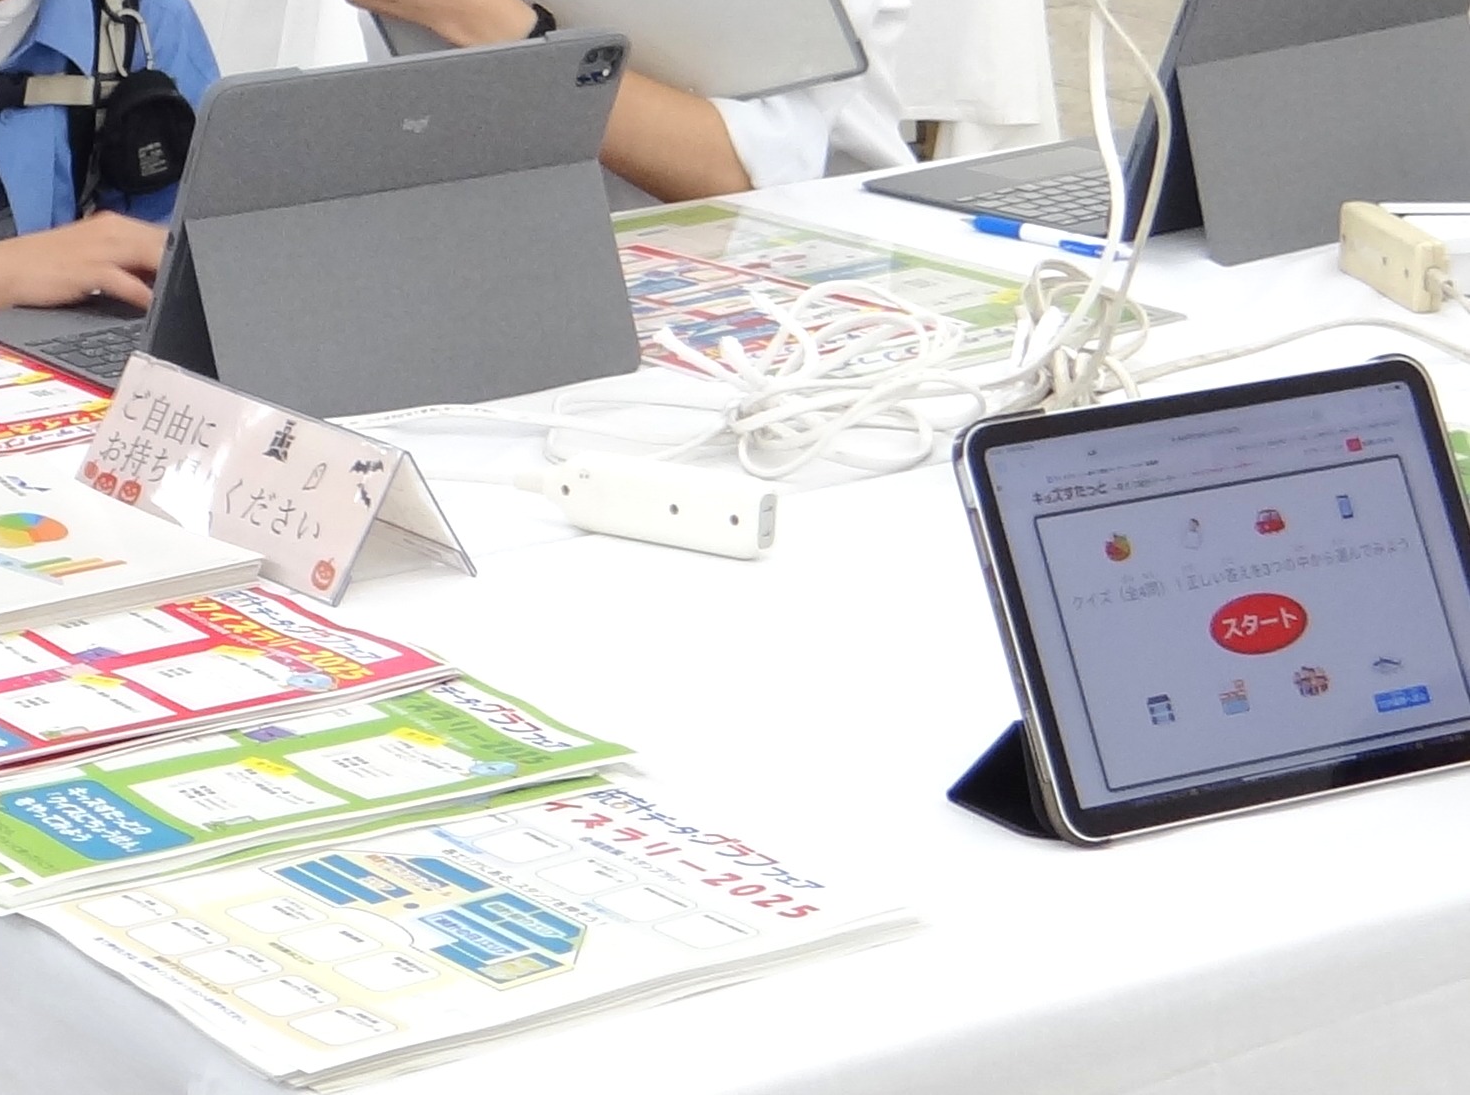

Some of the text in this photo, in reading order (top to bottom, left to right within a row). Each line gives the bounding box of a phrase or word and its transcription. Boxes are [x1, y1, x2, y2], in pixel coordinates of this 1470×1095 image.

[123, 390, 217, 448] ご自由に
[99, 431, 212, 482] お持ち
[225, 479, 321, 539] ください
[1031, 482, 1108, 505] キッズすたっと
[1220, 605, 1299, 639] スタート
